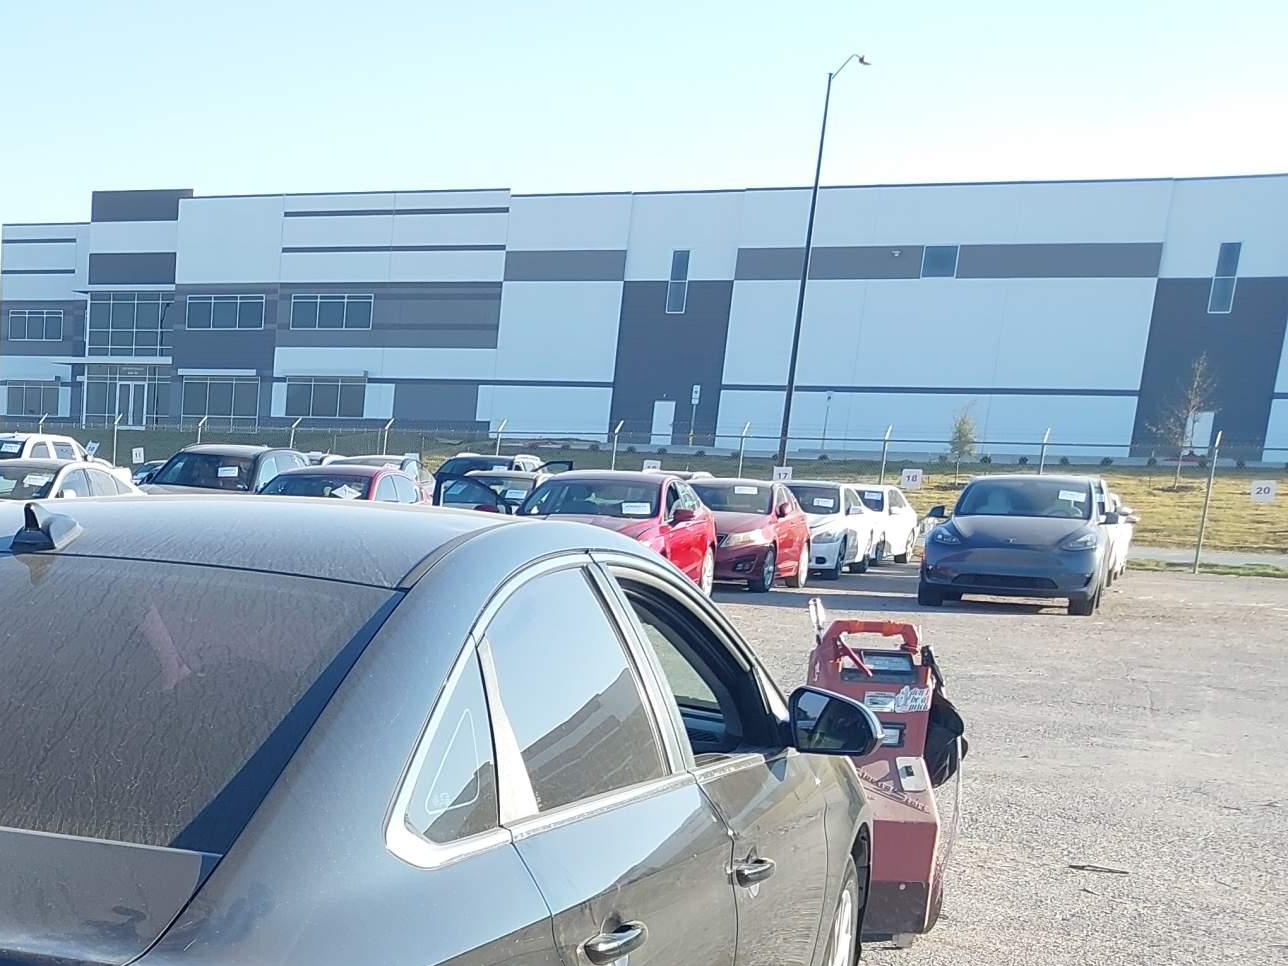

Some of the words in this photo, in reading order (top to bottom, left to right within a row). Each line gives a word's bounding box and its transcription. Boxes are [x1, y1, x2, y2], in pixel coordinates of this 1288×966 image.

[777, 472, 788, 480] 17
[906, 474, 918, 482] 18
[1256, 486, 1271, 495] 20
